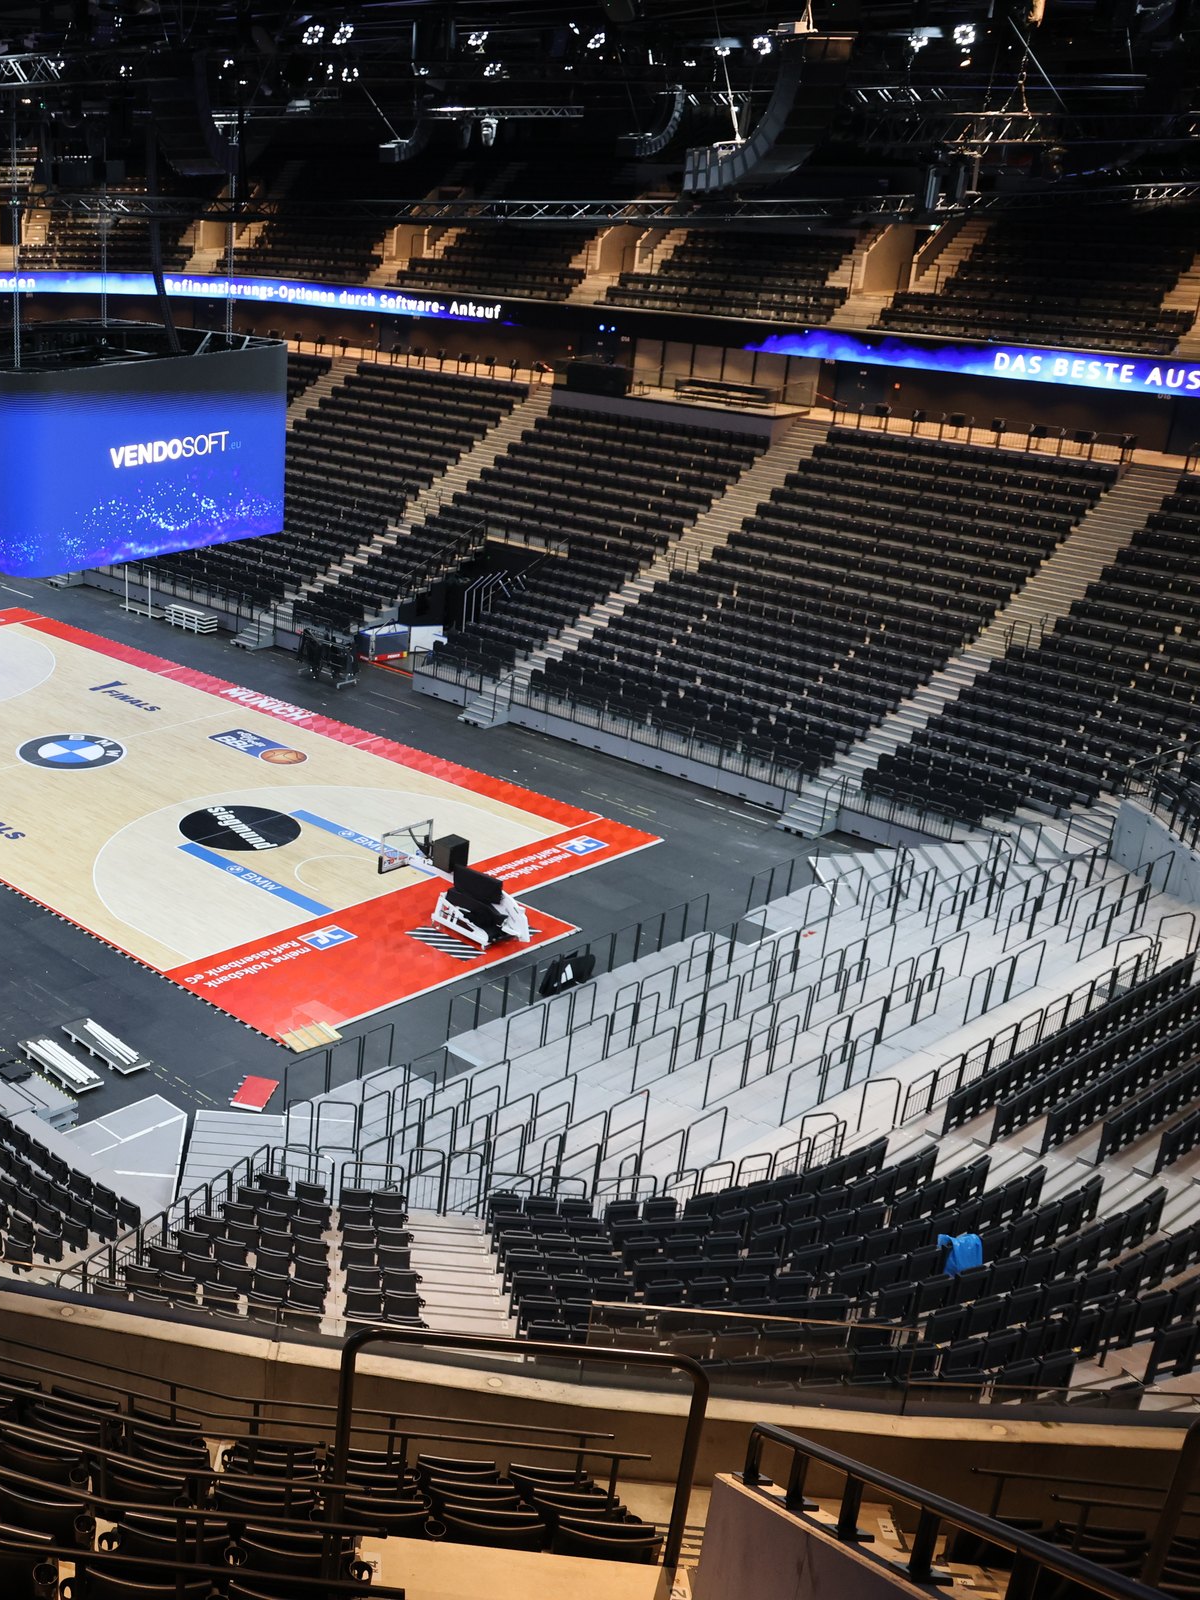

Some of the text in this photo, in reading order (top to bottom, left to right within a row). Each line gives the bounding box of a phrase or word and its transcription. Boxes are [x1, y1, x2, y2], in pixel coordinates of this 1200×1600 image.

[339, 291, 376, 307] durch
[449, 300, 502, 320] Ankauf
[993, 352, 1200, 391] DAS BESTE AUS
[101, 689, 161, 712] FINALS
[220, 687, 312, 721] MUNICH
[214, 735, 254, 752] BBL
[207, 806, 279, 850] siegmund
[240, 872, 282, 891] BMW
[184, 939, 301, 985] Raiffeisenbank eG
[203, 946, 312, 988] meine Volksbank
